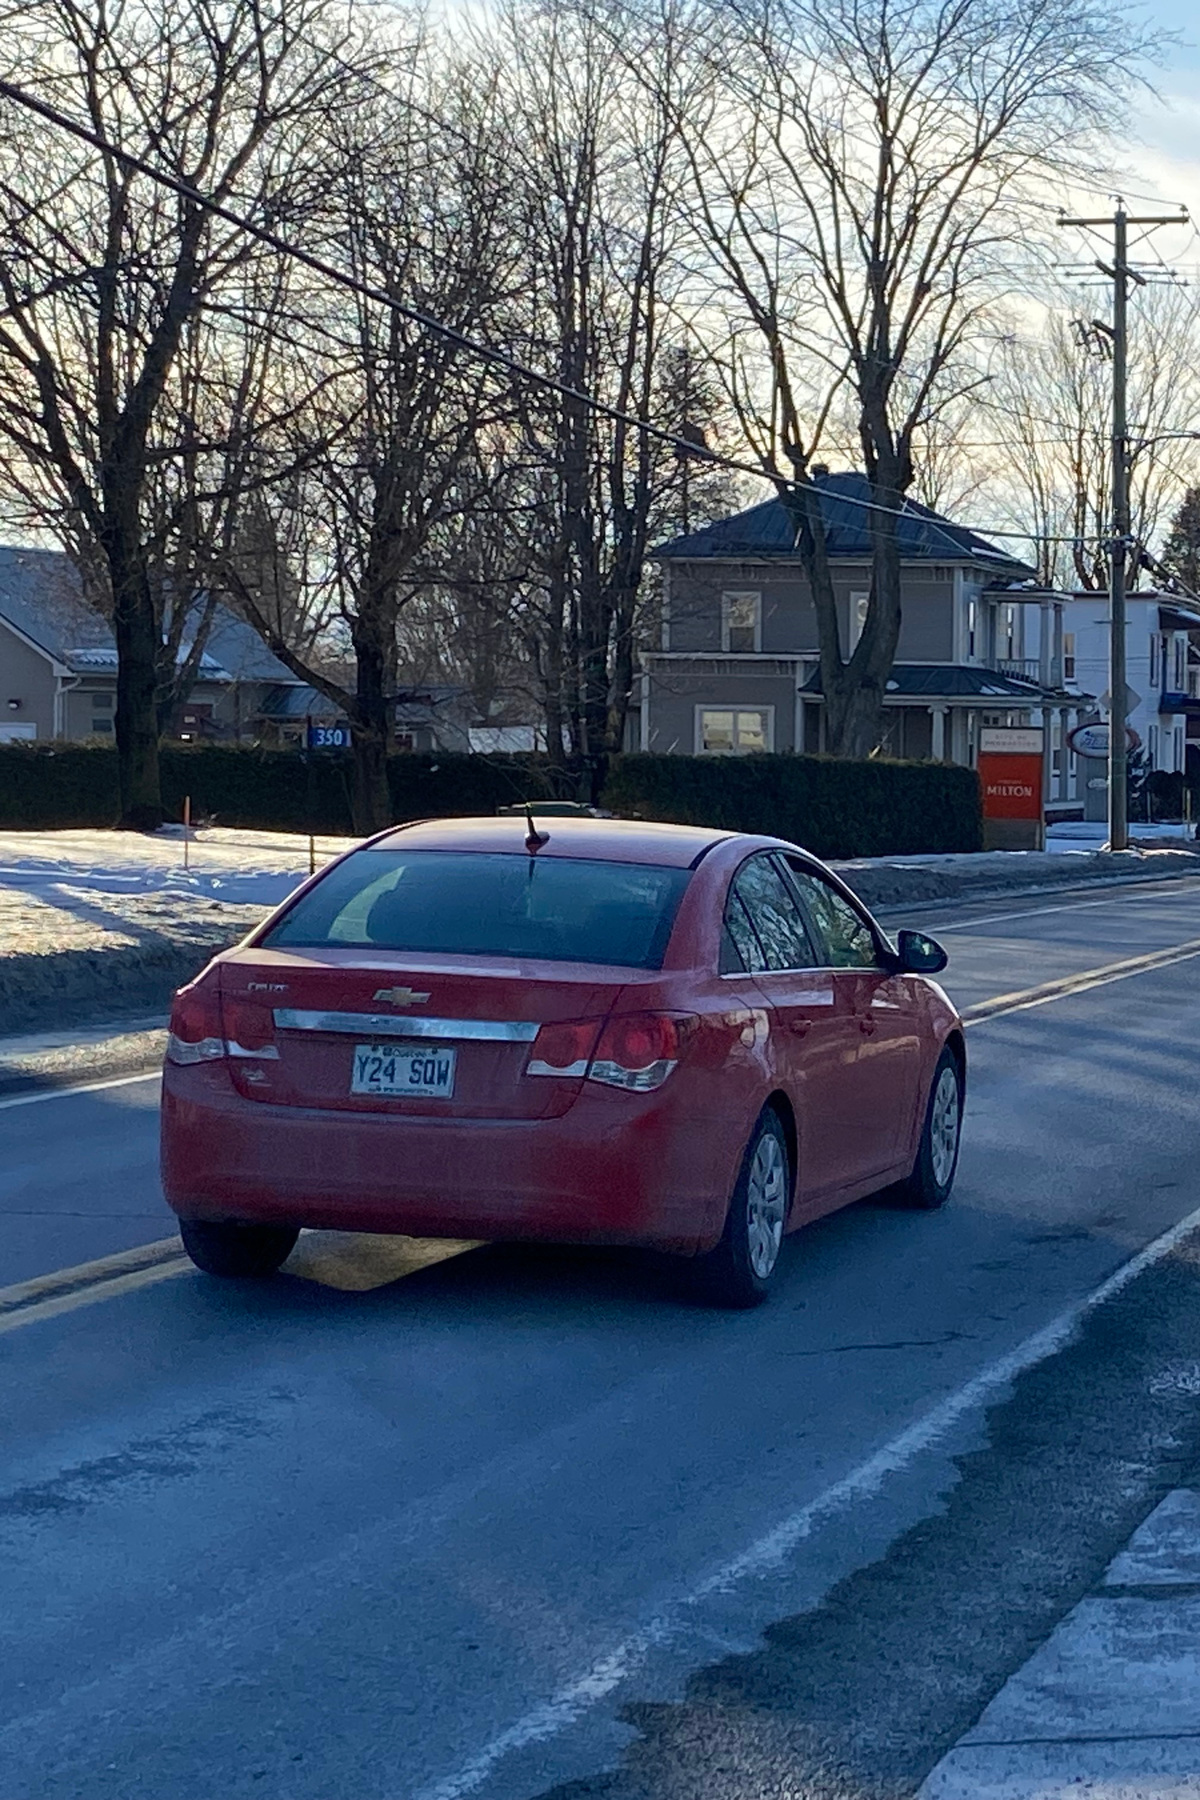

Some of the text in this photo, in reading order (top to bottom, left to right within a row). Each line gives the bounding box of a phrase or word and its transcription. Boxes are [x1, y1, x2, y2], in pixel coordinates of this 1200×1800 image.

[317, 729, 343, 746] 350
[987, 785, 1032, 797] MILTON
[357, 1054, 450, 1086] Y24 SQW
